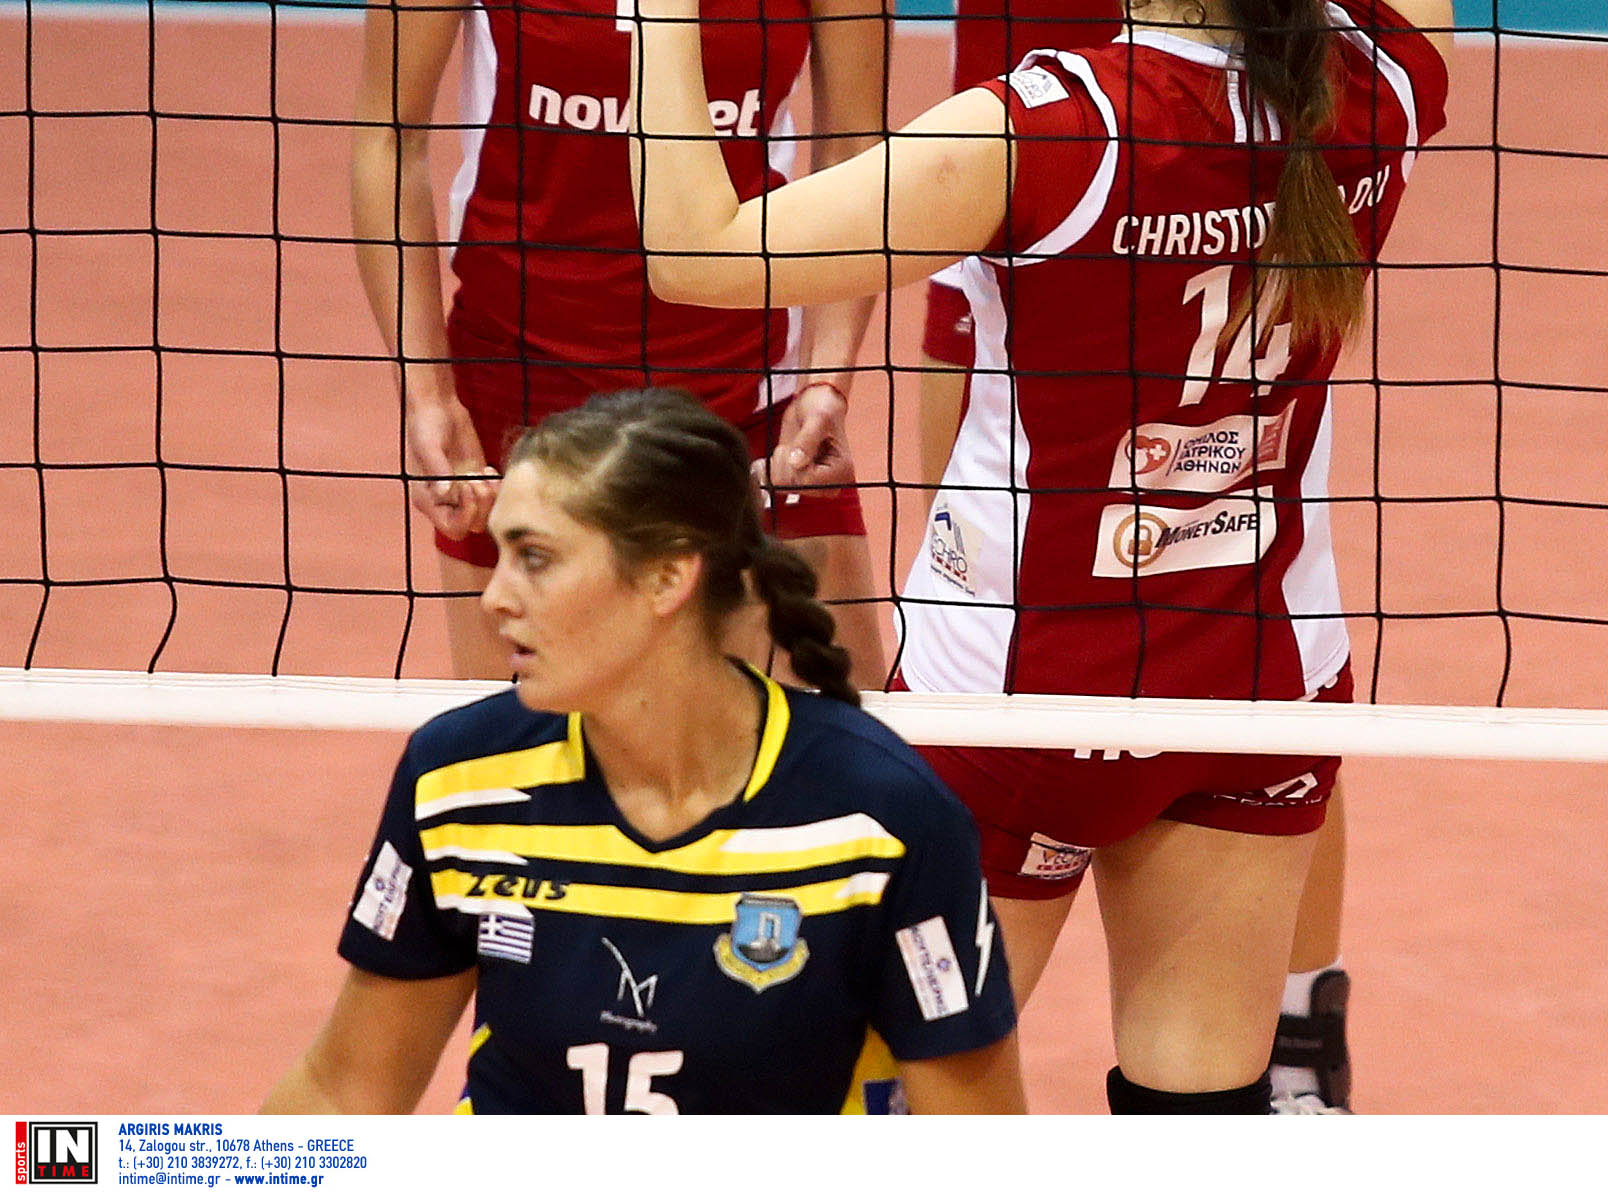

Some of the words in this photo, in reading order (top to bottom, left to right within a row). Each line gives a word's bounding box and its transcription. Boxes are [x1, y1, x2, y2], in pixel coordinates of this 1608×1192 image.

[529, 83, 764, 138] novet
[1178, 254, 1293, 408] 14
[566, 1042, 684, 1115] 15
